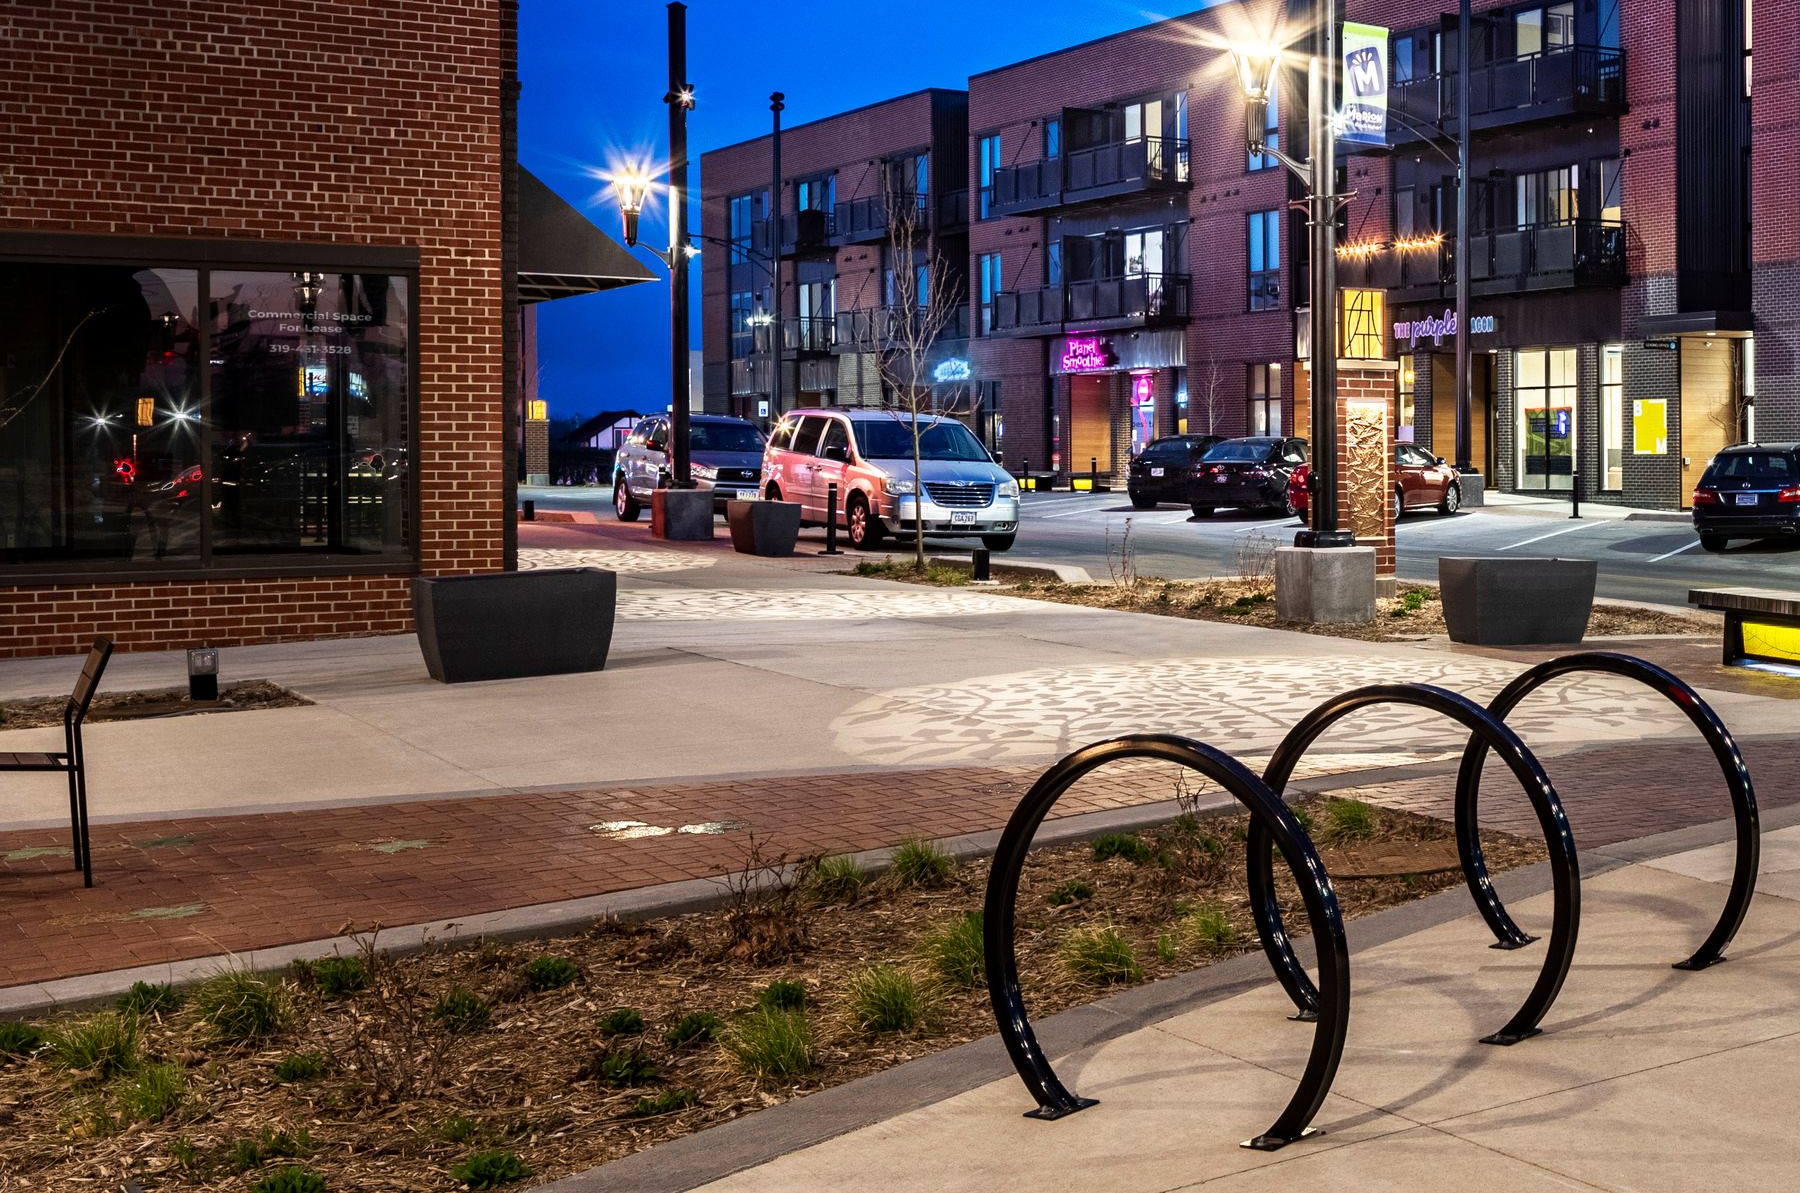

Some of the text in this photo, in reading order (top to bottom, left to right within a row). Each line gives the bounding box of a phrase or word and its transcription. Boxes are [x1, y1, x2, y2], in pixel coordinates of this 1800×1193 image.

[247, 309, 373, 322] Commercial Space
[279, 323, 343, 333] For Lease
[1393, 322, 1410, 339] THE
[1411, 308, 1457, 348] purple
[1069, 339, 1096, 356] Planet
[1062, 353, 1103, 370] Smoothie
